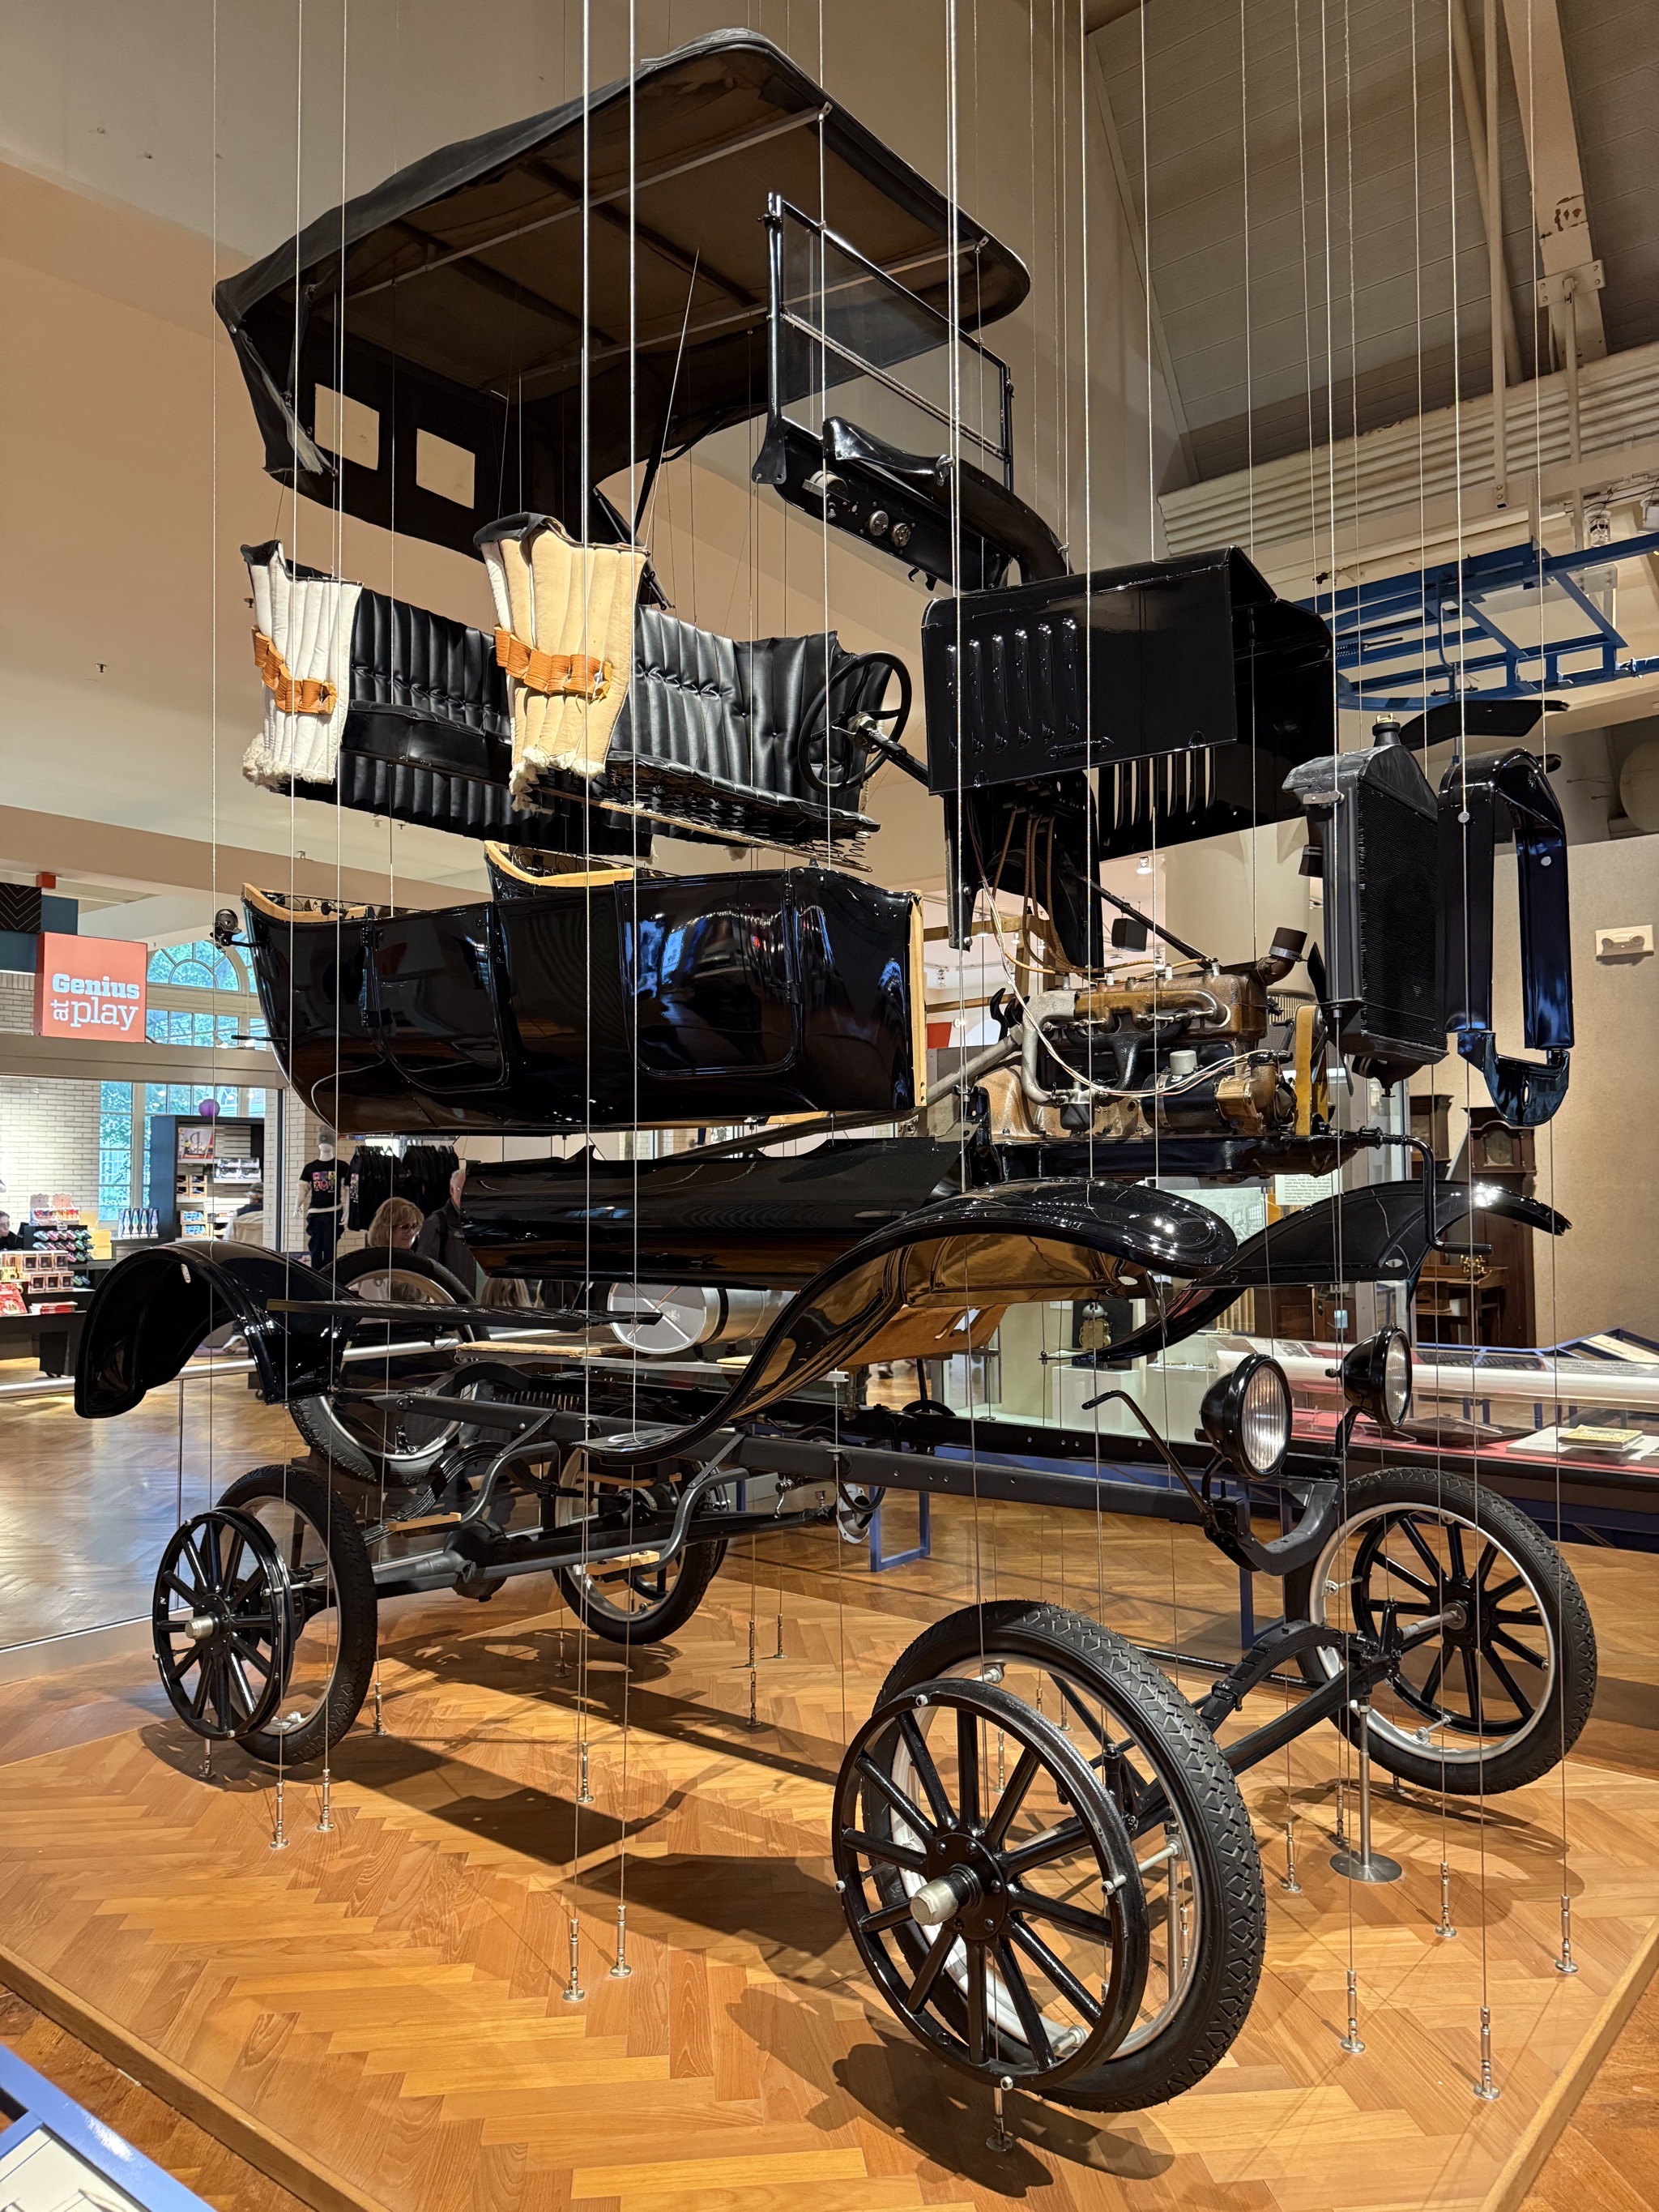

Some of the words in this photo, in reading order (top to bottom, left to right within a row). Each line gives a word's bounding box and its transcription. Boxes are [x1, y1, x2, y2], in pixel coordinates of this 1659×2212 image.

[52, 973, 140, 1000] Genius
[50, 998, 70, 1022] at
[70, 996, 139, 1031] play
